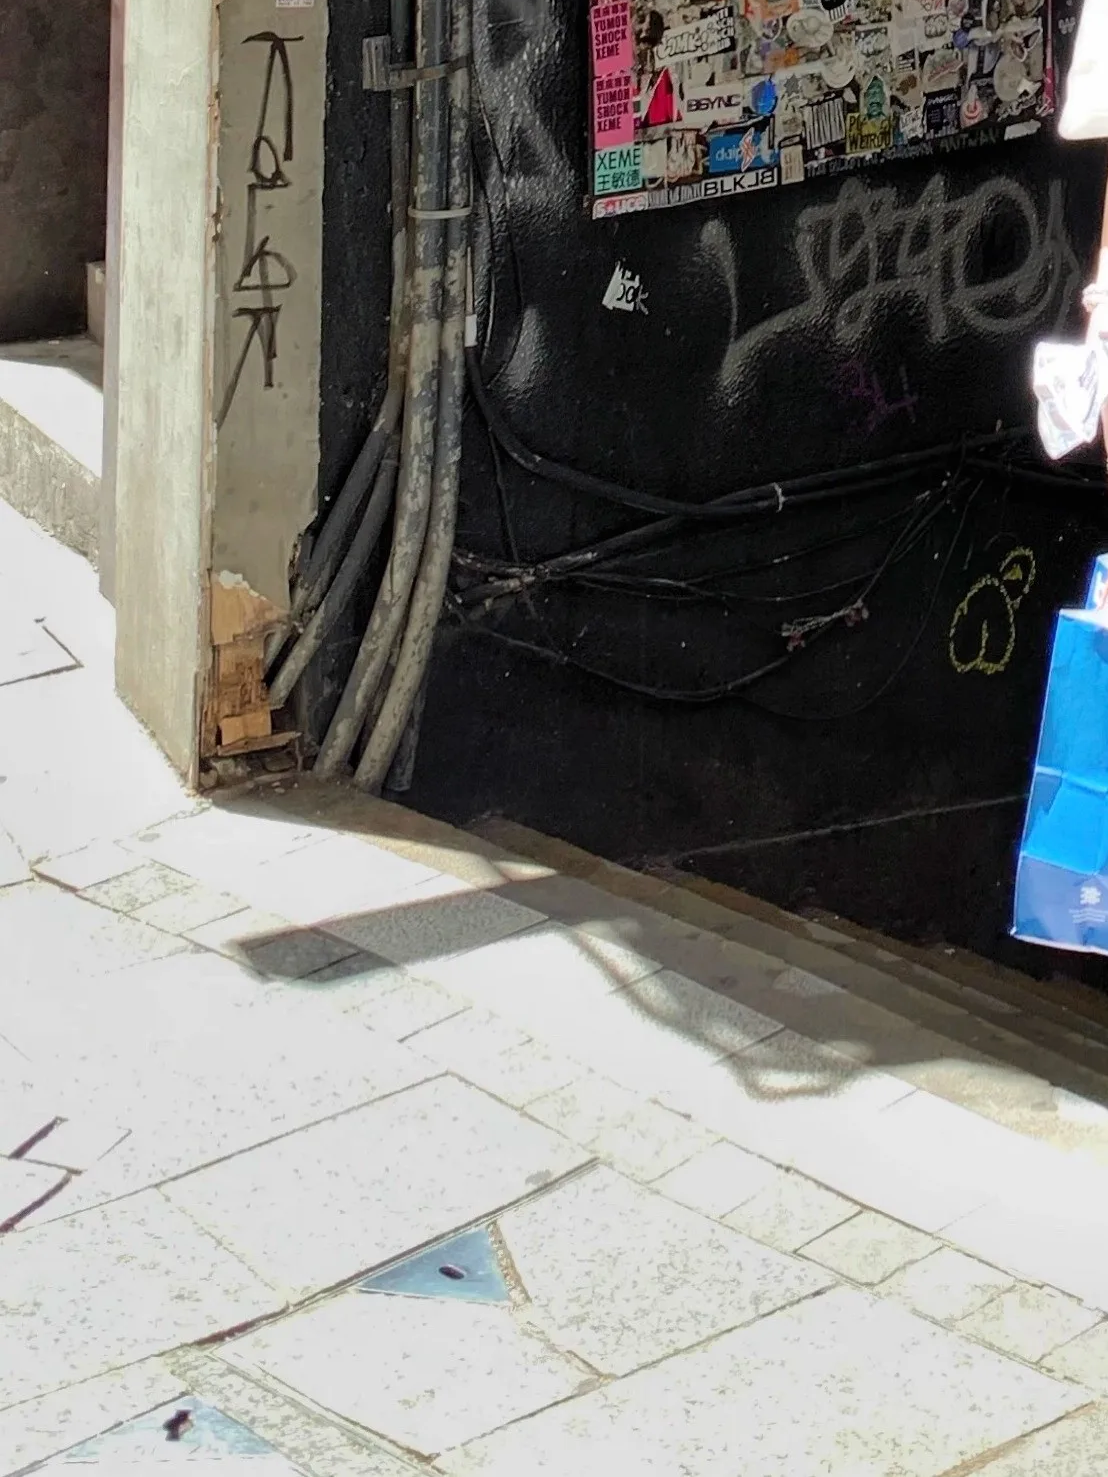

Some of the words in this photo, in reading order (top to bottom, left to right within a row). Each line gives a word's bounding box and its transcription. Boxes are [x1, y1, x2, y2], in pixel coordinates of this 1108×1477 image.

[594, 29, 628, 47] SHOCK
[595, 44, 620, 60] XEME
[597, 102, 629, 119] SHOCK
[686, 94, 741, 112] BSYNC
[597, 117, 622, 133] XEME
[596, 147, 641, 172] XEME
[597, 169, 640, 193] 王敏德
